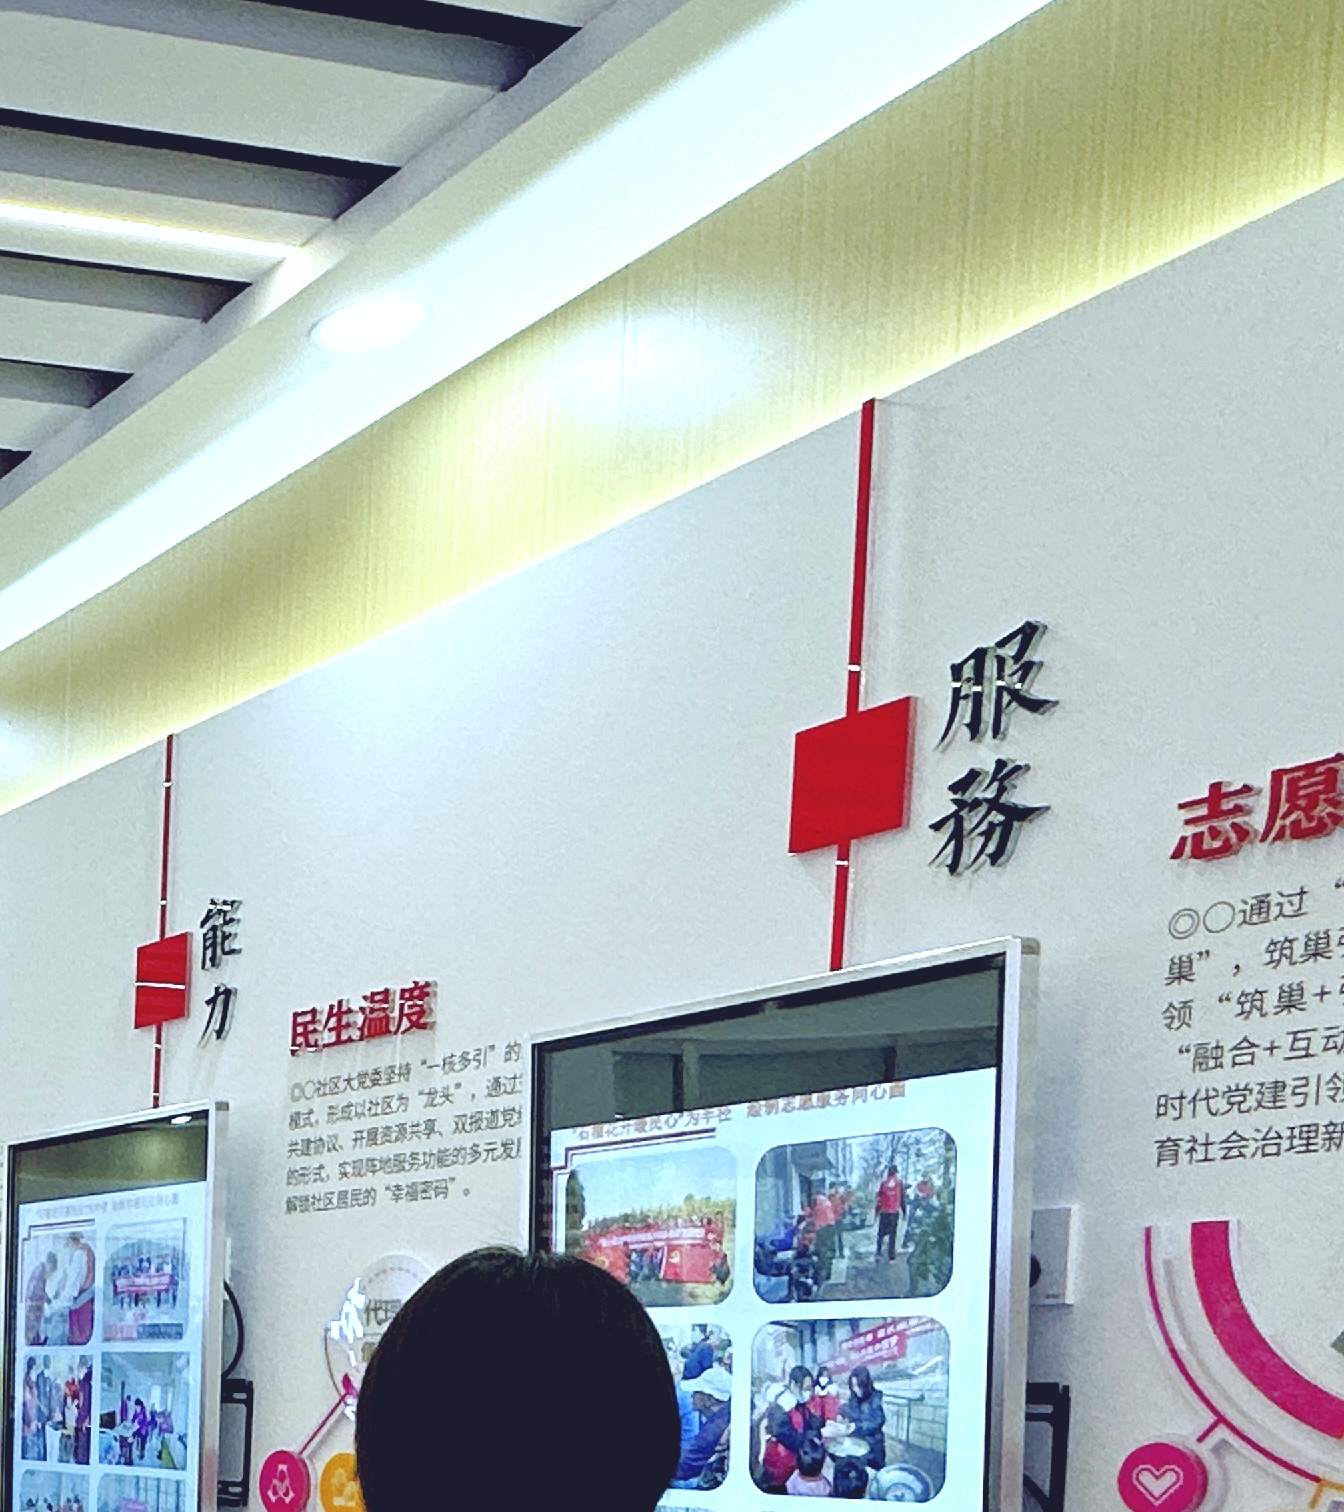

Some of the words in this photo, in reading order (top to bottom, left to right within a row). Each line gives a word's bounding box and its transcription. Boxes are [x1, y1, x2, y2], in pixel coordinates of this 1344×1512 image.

[929, 619, 1059, 876] 服務
[1169, 752, 1344, 862] 志愿
[199, 897, 243, 1046] 能力
[1164, 926, 1344, 986] 巢”，筑巢
[289, 980, 436, 1056] 民生温度
[1161, 974, 1344, 1032] 领“筑巢+
